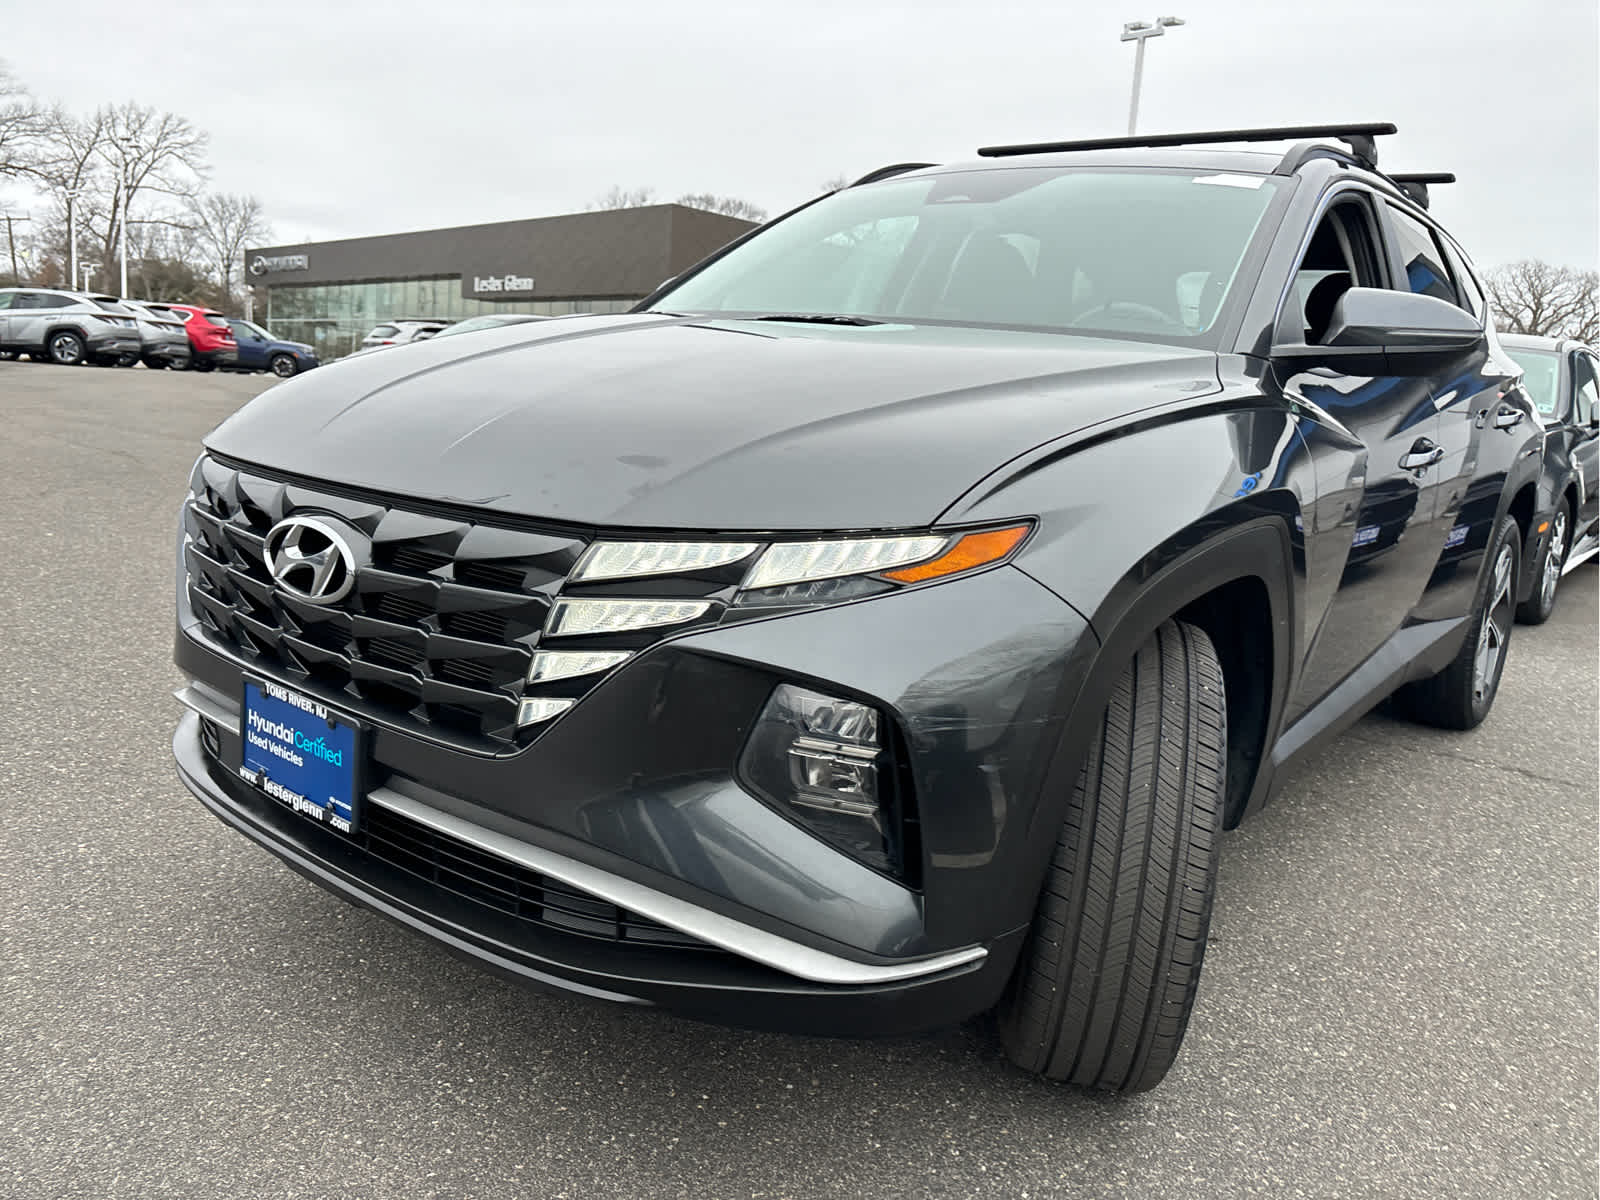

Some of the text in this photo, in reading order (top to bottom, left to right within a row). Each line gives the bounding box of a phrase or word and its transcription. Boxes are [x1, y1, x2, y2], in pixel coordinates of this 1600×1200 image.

[473, 275, 534, 292] Lester Glenn
[264, 681, 328, 719] TOMS RIVER, NJ
[248, 708, 342, 767] Hyundai Certified
[248, 731, 269, 750] Used
[269, 742, 303, 767] Vehicles
[239, 767, 257, 784] www.
[263, 776, 323, 821] lesterglenn
[329, 814, 350, 833] .com
